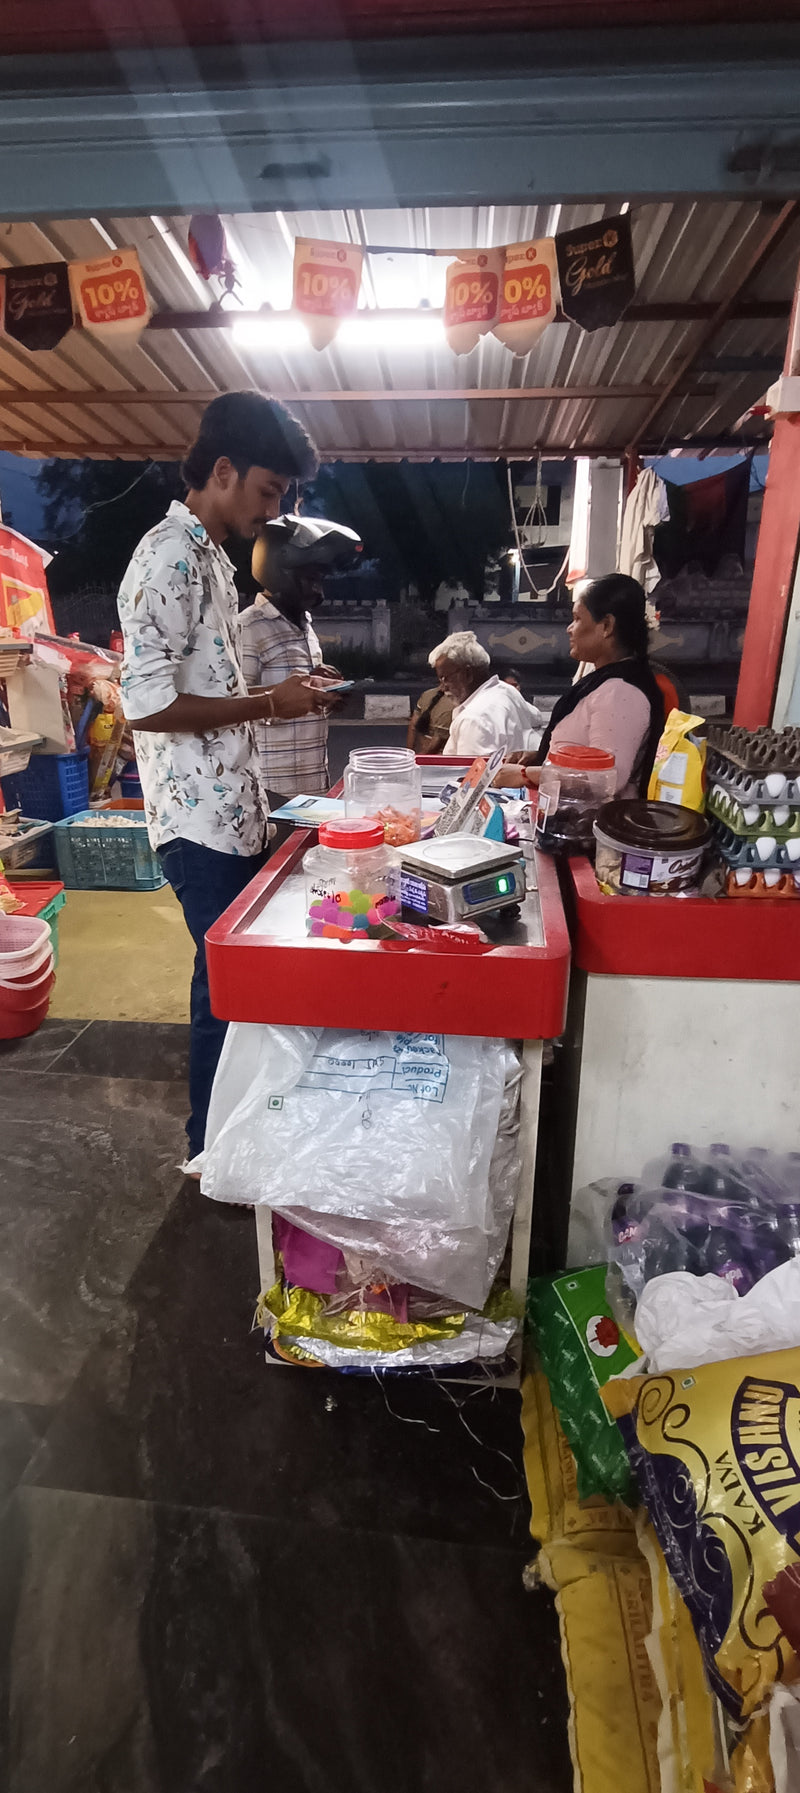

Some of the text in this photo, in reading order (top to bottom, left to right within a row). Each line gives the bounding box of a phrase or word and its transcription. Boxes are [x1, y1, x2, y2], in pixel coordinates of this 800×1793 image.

[301, 271, 352, 299] 10%
[504, 274, 547, 303] 0%
[566, 252, 617, 296] Gold
[85, 278, 139, 309] 10%
[738, 1384, 800, 1517] VISHNU
[715, 1450, 766, 1536] KALVA
